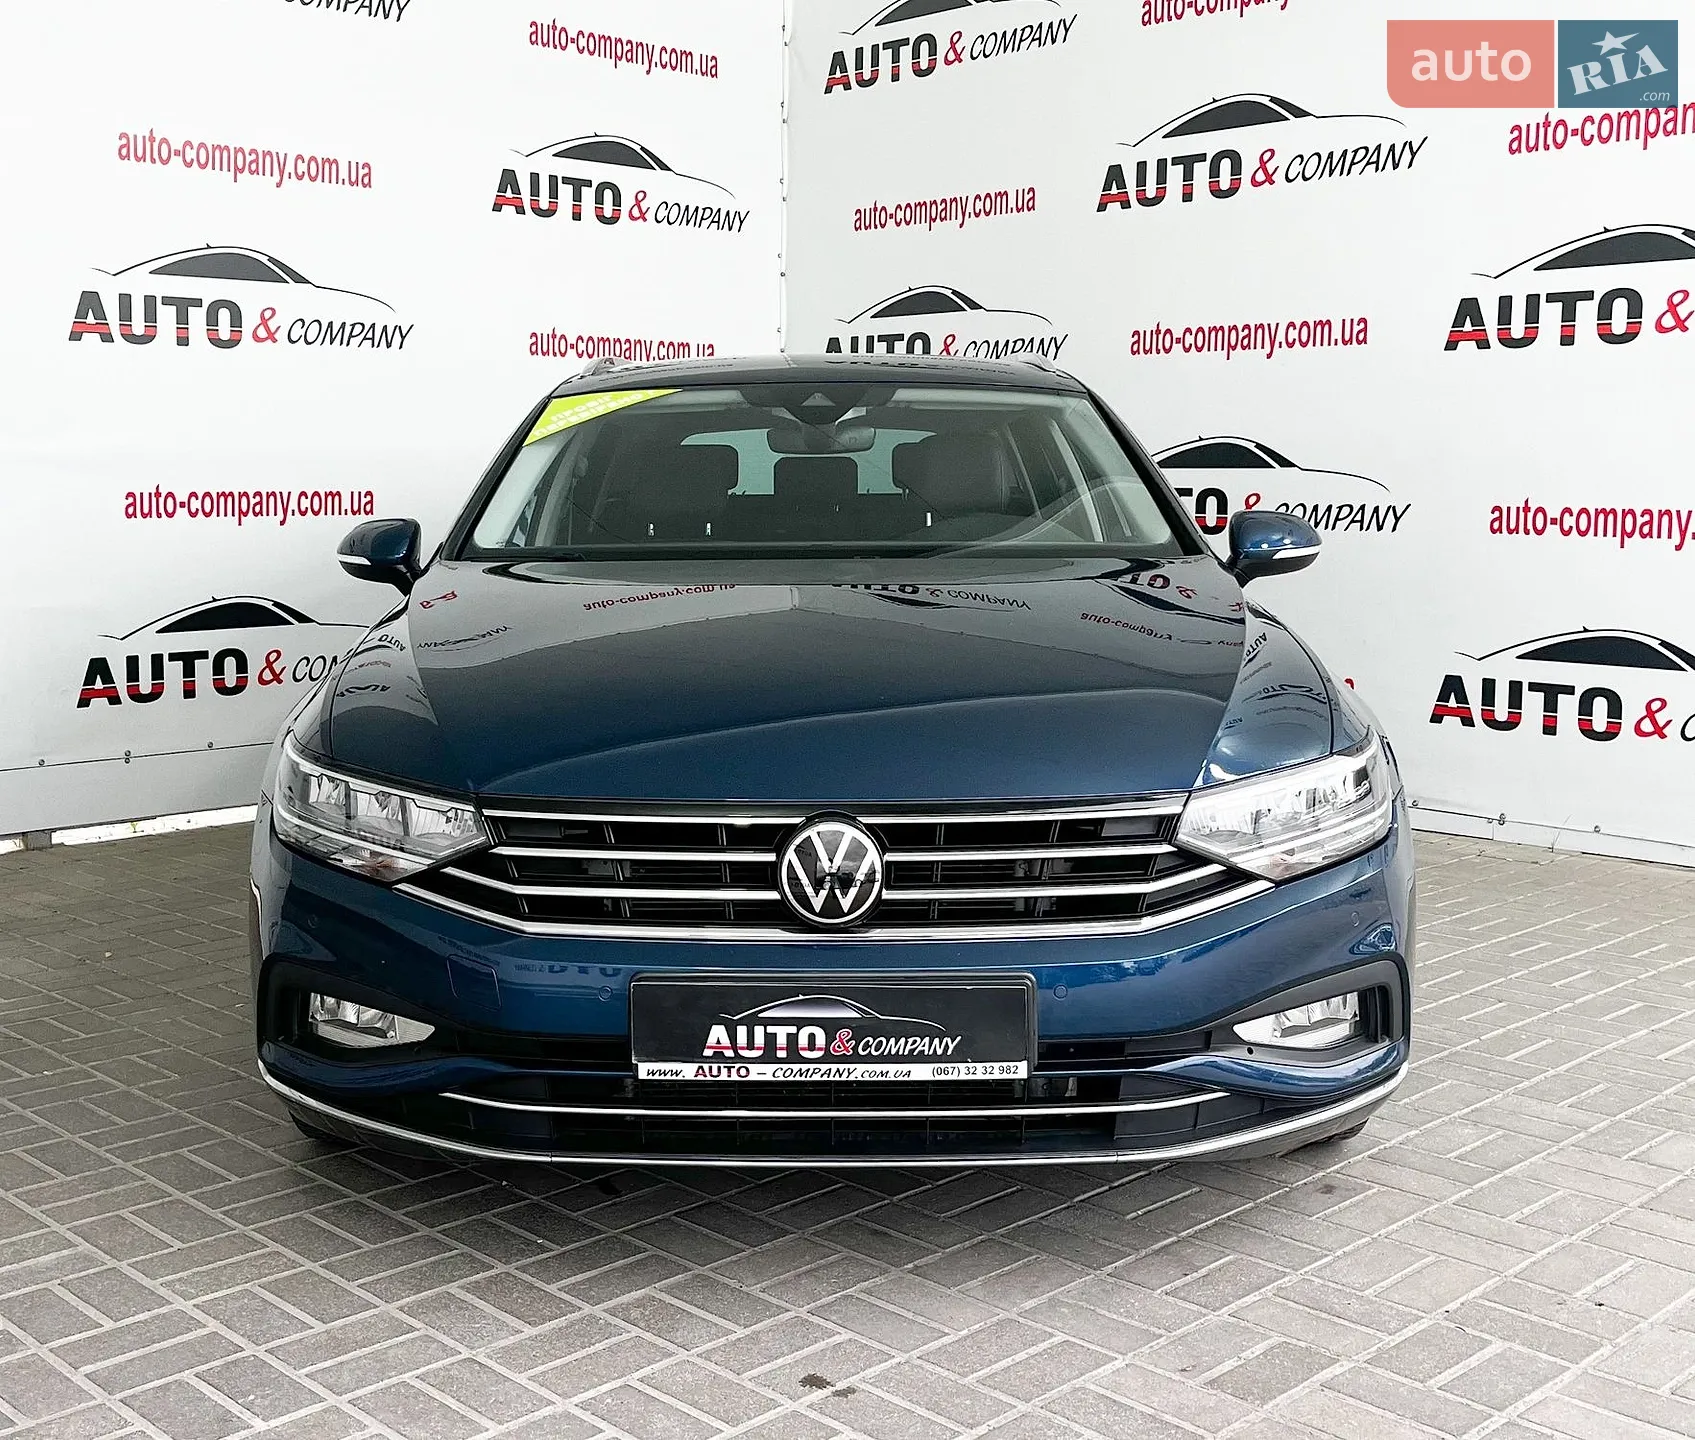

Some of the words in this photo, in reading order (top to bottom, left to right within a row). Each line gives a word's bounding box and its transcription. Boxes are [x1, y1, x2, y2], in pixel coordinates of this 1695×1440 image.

[529, 18, 718, 79] auto-company.com.ua
[824, 33, 938, 95] AUTO
[943, 30, 966, 67] &
[969, 13, 1078, 61] COMPANY
[117, 128, 372, 189] auto-company.com.ua
[1096, 147, 1243, 213] AUTO
[1250, 148, 1280, 188] &
[1284, 135, 1429, 184] COMPANY
[491, 167, 623, 227] AUTO
[628, 189, 651, 223] &
[654, 194, 751, 234] COMPANY
[853, 186, 1036, 232] auto-company.com.ua
[68, 290, 243, 350] AUTO
[251, 306, 281, 344] &
[287, 317, 415, 350] COMPANY
[529, 327, 715, 362] auto-company.comua
[1130, 317, 1368, 361] auto-company.com.ua
[1443, 287, 1644, 352] AUTO
[1654, 289, 1695, 334] &
[124, 483, 375, 526] auto-company.com.ua
[76, 647, 249, 709] AUTO
[257, 648, 287, 687] &
[1428, 674, 1623, 742] AUTO
[1633, 697, 1673, 740] &
[702, 1024, 827, 1059] AUTO
[829, 1028, 856, 1056] &
[857, 1034, 962, 1057] COMPANY
[931, 1065, 961, 1078] (067)
[964, 1066, 977, 1076] 32
[981, 1066, 995, 1076] 32
[998, 1065, 1020, 1075] 982
[646, 1067, 686, 1079] www.
[693, 1065, 751, 1079] AUTO
